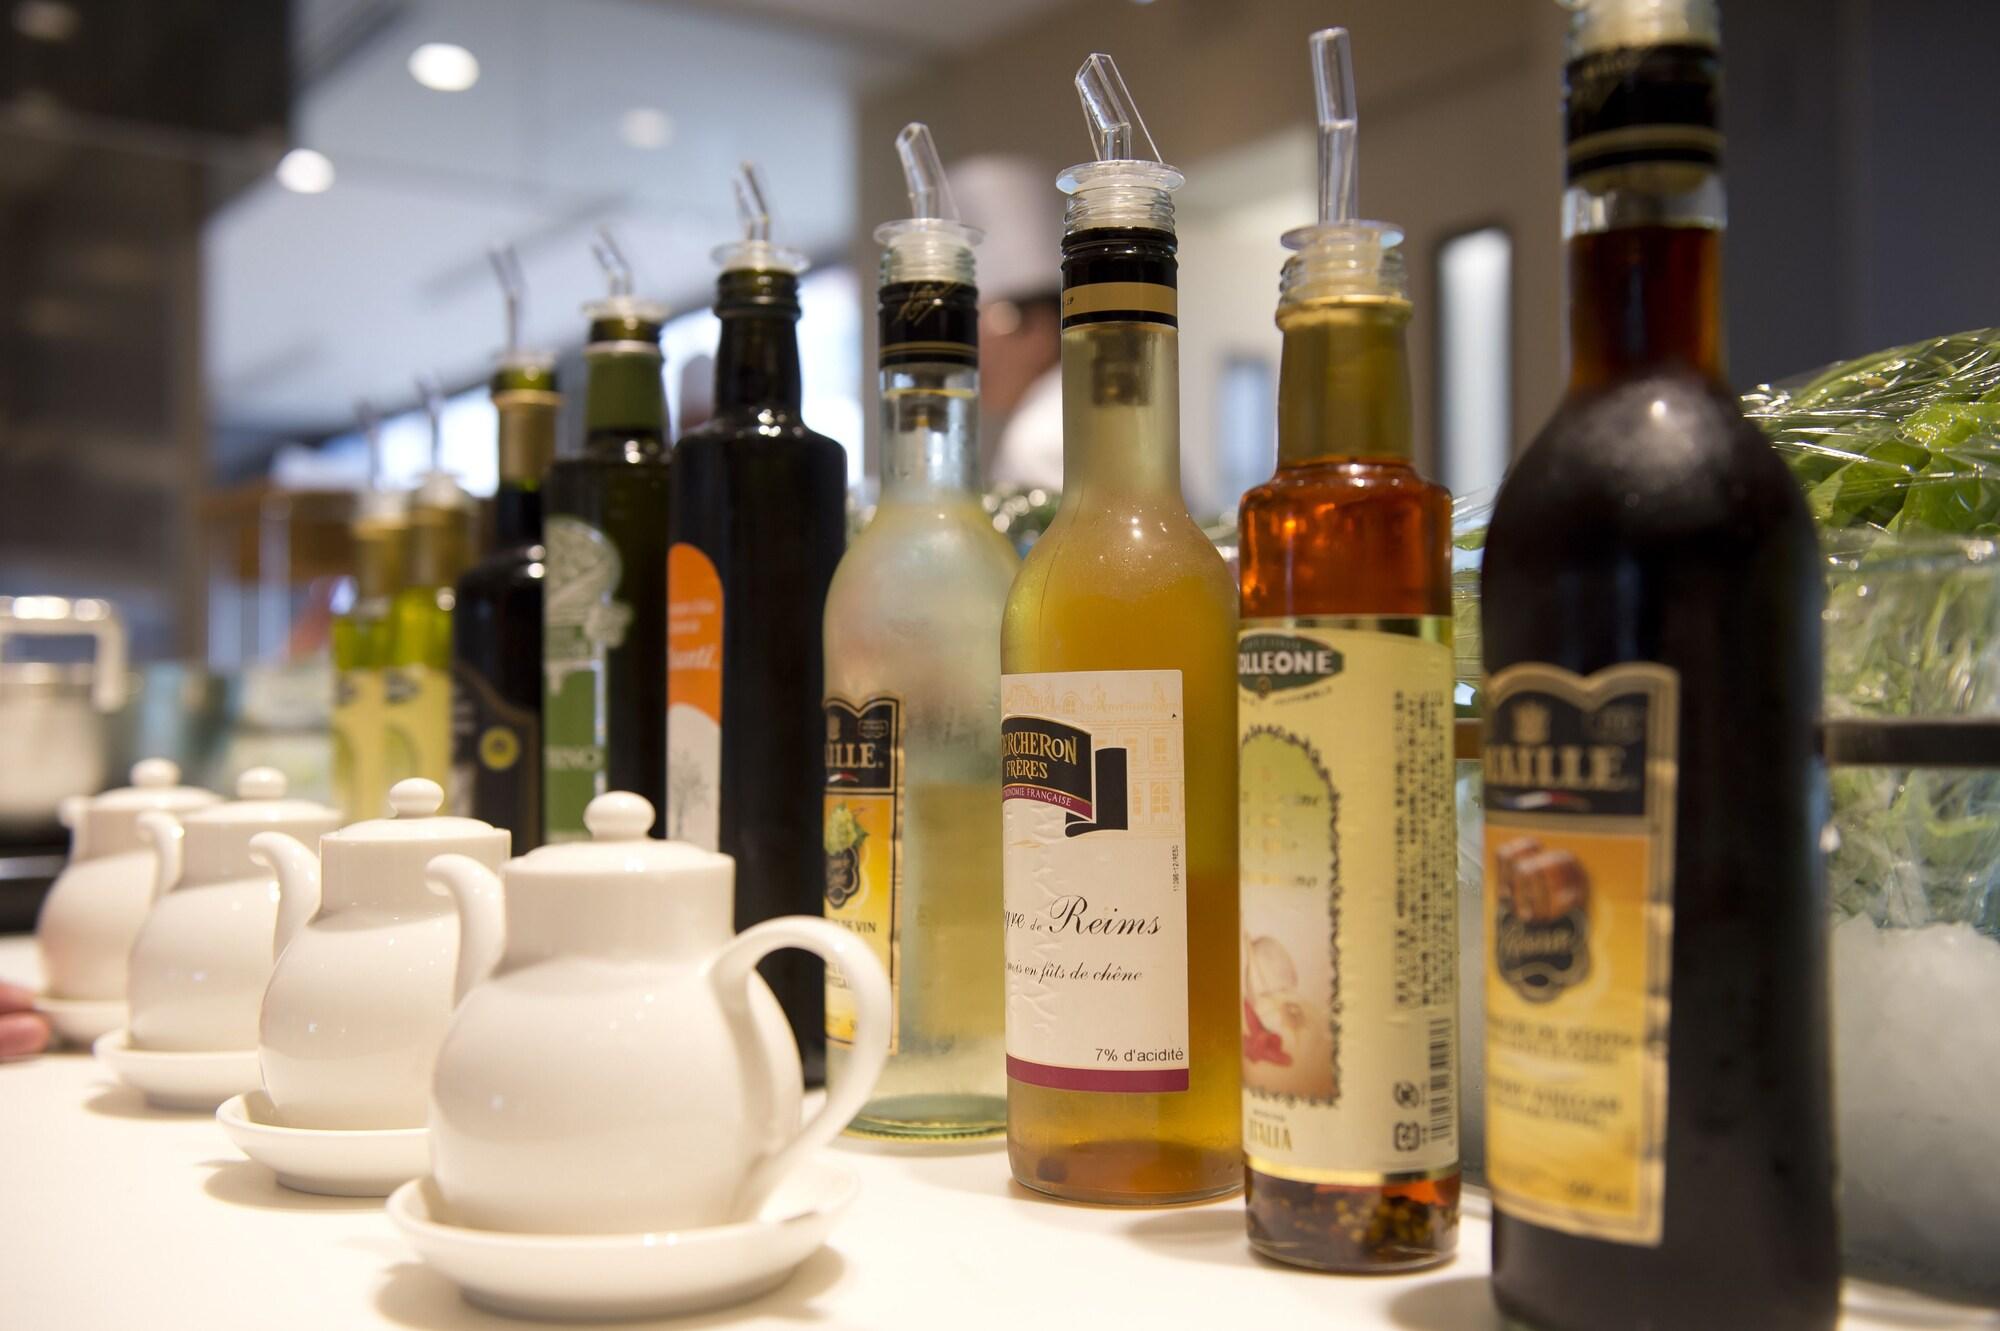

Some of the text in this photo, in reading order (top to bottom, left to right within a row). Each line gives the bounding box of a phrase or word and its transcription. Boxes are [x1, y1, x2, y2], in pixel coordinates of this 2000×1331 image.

[1006, 757, 1048, 779] FRÈRES
[1027, 787, 1072, 806] FRANÇAISE
[1030, 917, 1042, 931] de
[1049, 894, 1161, 935] Reims
[1024, 965, 1038, 976] en
[1040, 961, 1065, 984] fûts
[1070, 962, 1089, 980] de
[1093, 960, 1143, 981] chêne
[1095, 1047, 1184, 1062] 7% d'acidité
